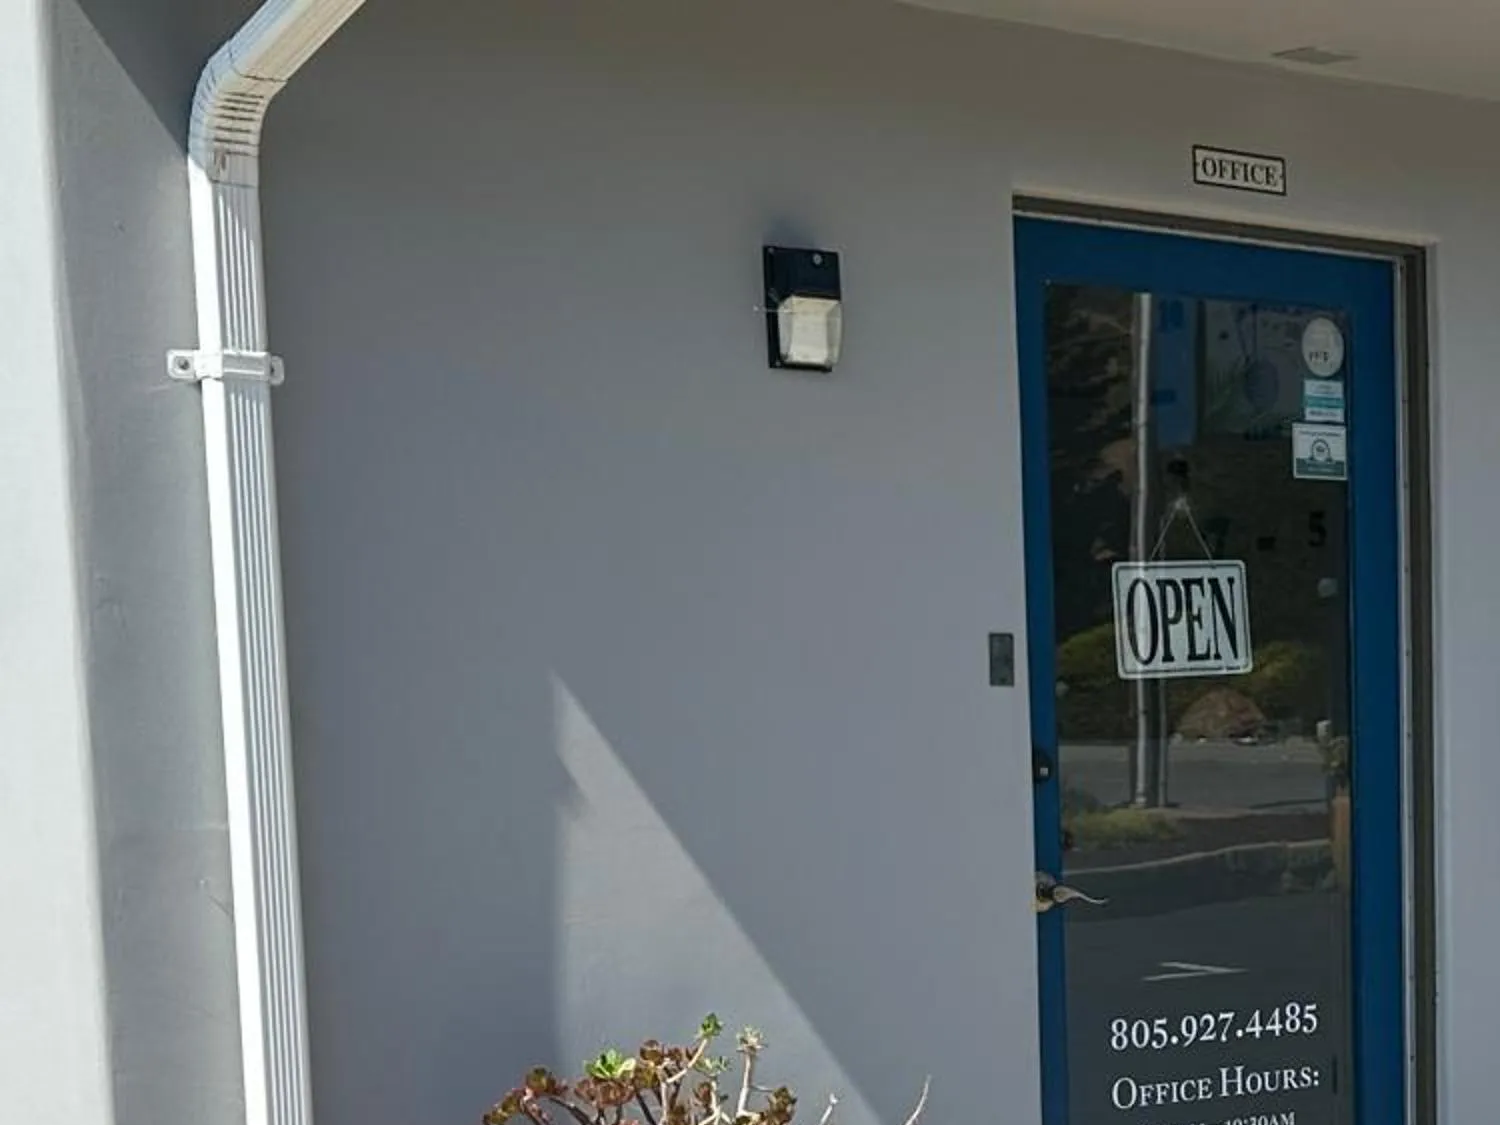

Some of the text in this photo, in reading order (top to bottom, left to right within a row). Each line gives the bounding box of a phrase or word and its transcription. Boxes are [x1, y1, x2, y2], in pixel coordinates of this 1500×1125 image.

[1201, 157, 1277, 187] OFFICE
[1126, 576, 1239, 666] OPEN
[1110, 1002, 1318, 1051] 805.927.4485
[1112, 1065, 1320, 1109] OFFICE HOURS:
